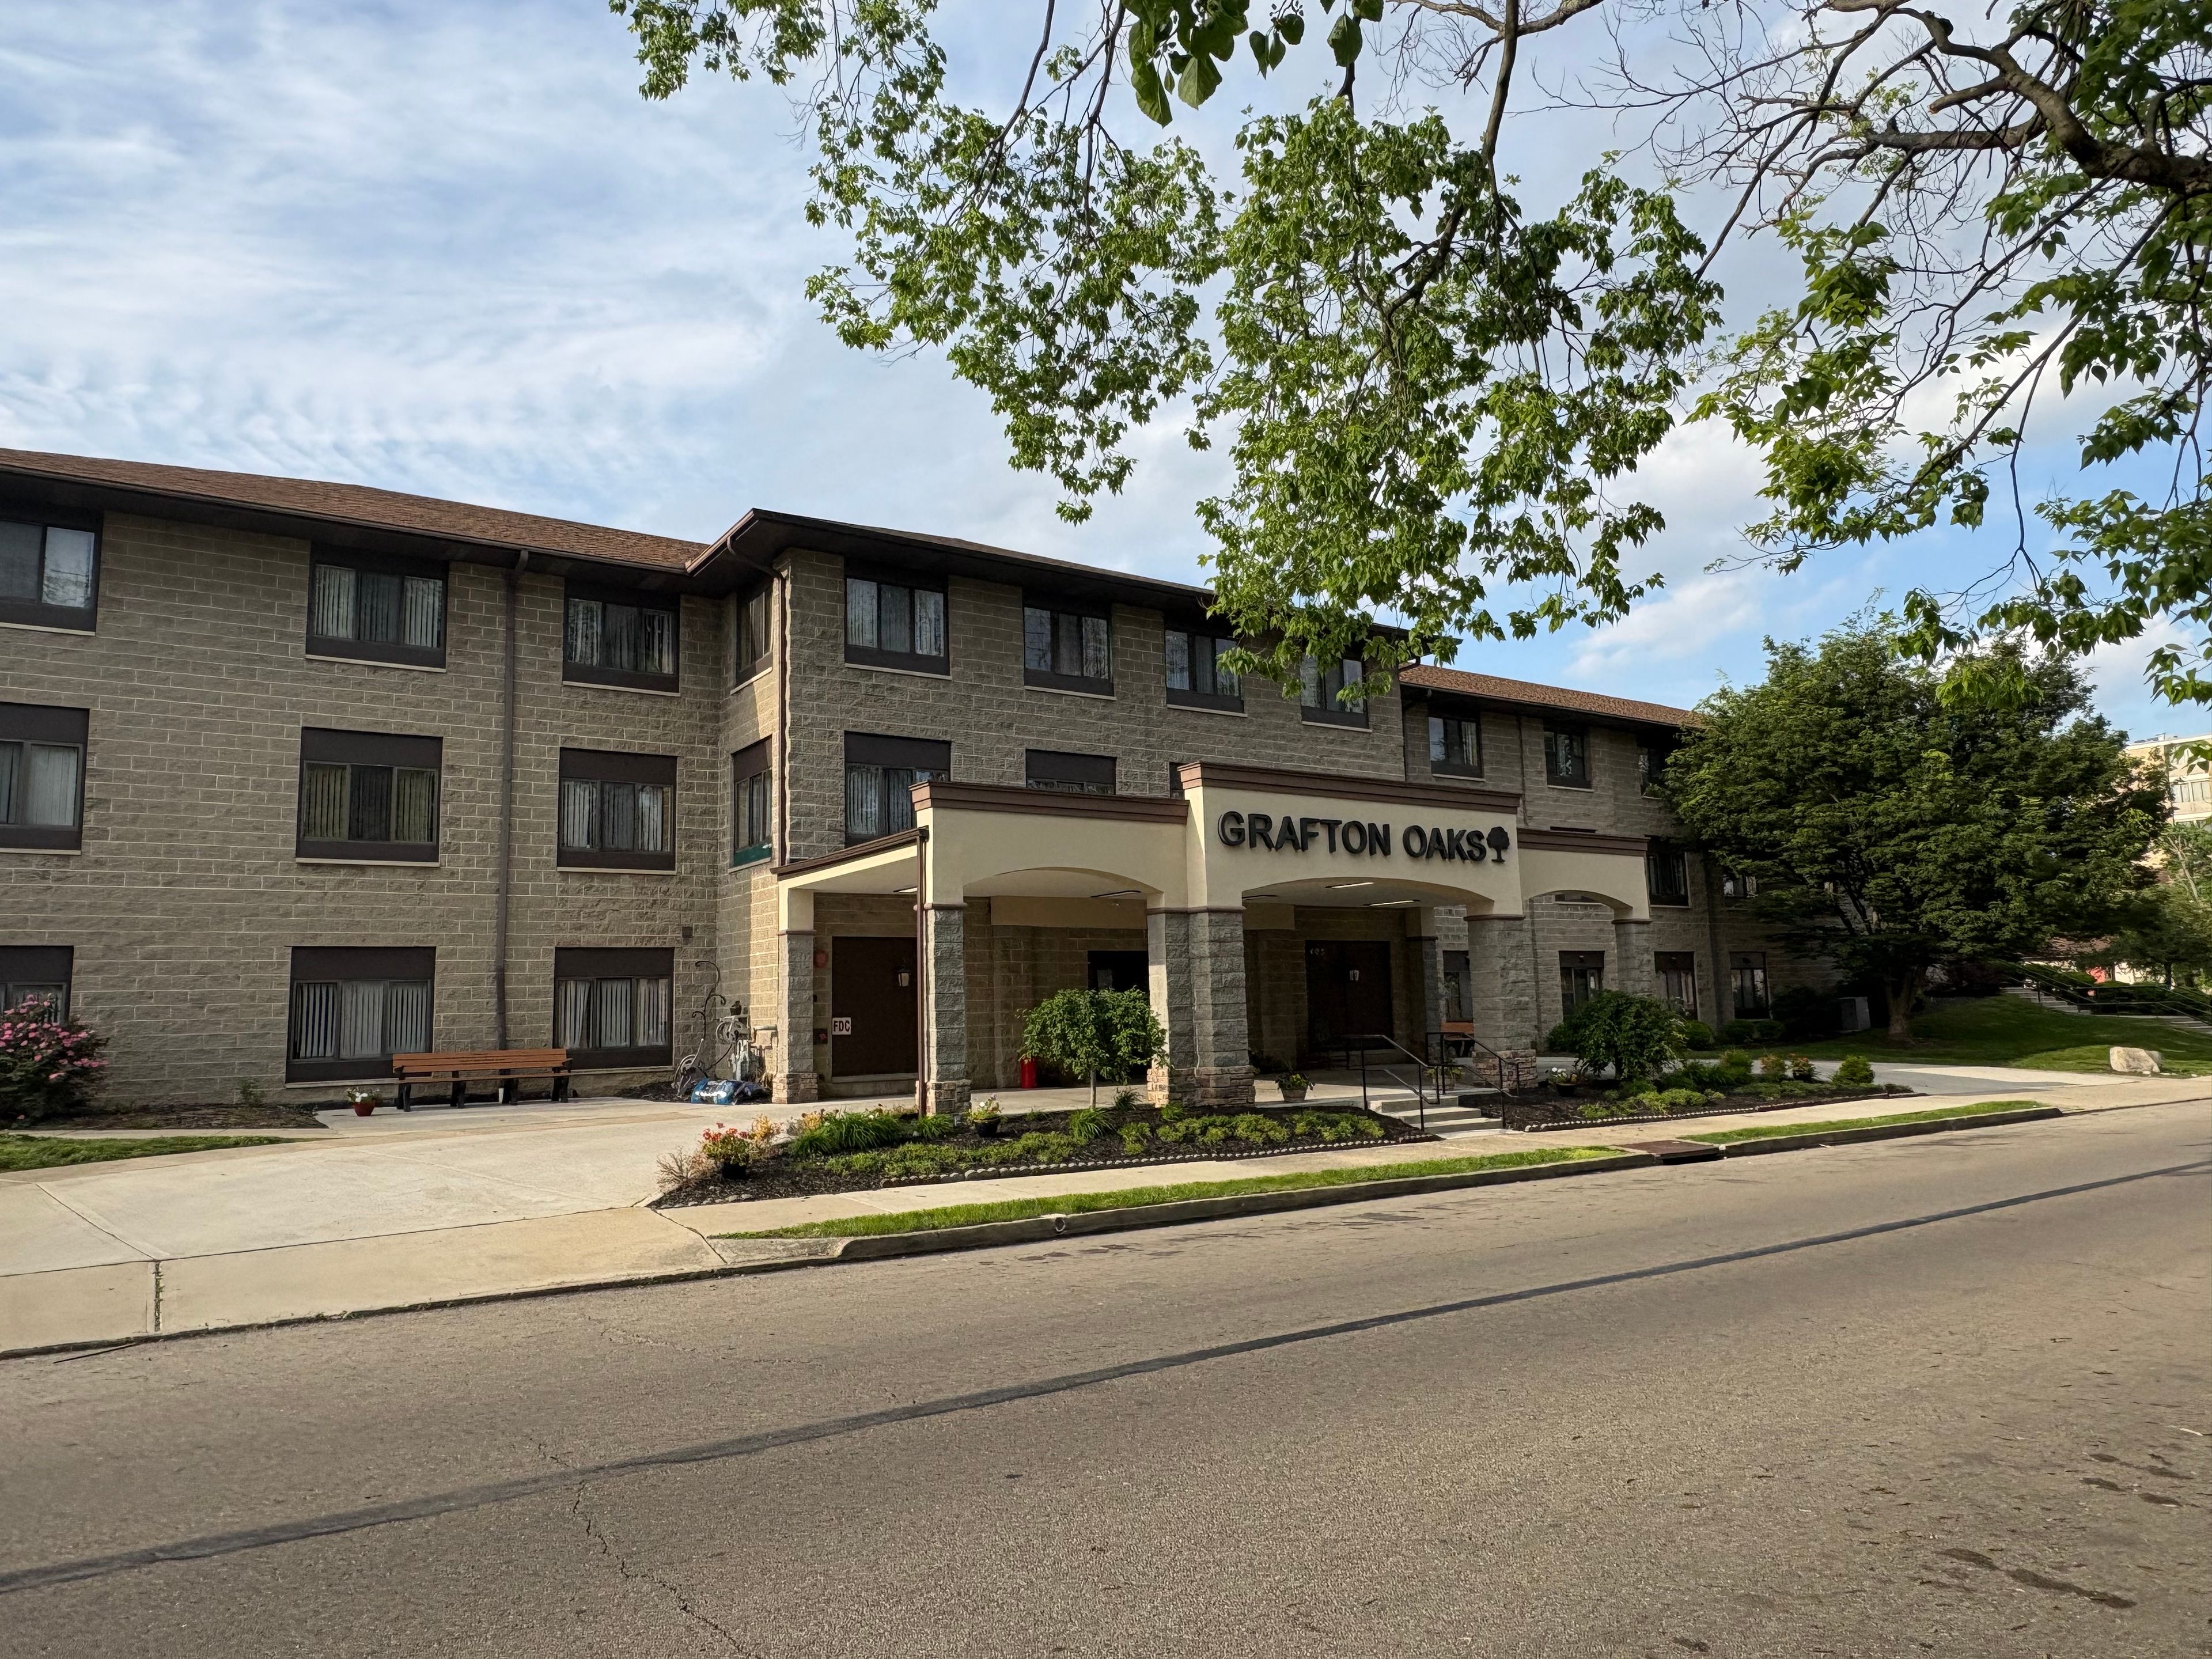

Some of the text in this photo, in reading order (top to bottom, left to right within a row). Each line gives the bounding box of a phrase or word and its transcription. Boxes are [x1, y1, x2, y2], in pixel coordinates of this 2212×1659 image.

[1218, 811, 1487, 862] GRAFTON OAKS
[834, 1020, 850, 1032] FDC
